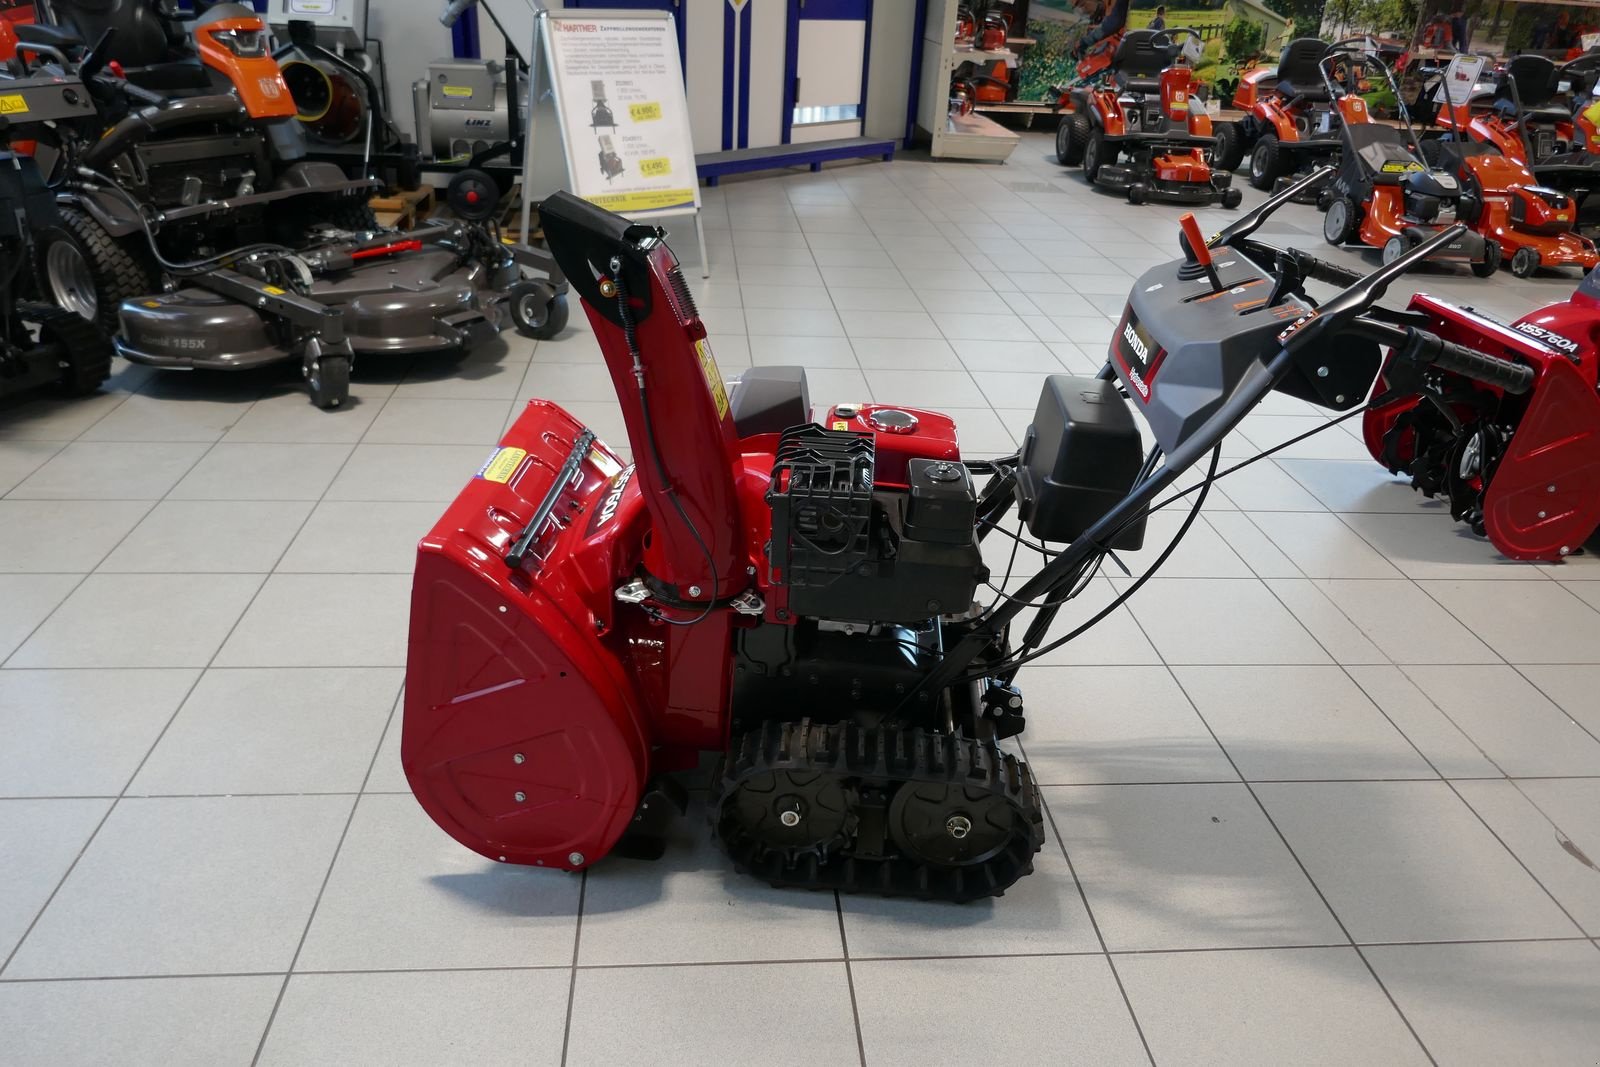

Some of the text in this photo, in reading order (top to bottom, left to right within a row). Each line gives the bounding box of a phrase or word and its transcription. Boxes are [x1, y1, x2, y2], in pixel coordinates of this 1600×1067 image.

[466, 119, 491, 127] LINZ
[173, 339, 206, 349] 155X
[1124, 322, 1148, 365] HONDA
[1515, 322, 1578, 353] HSS760A
[597, 463, 636, 527] HSS760A
